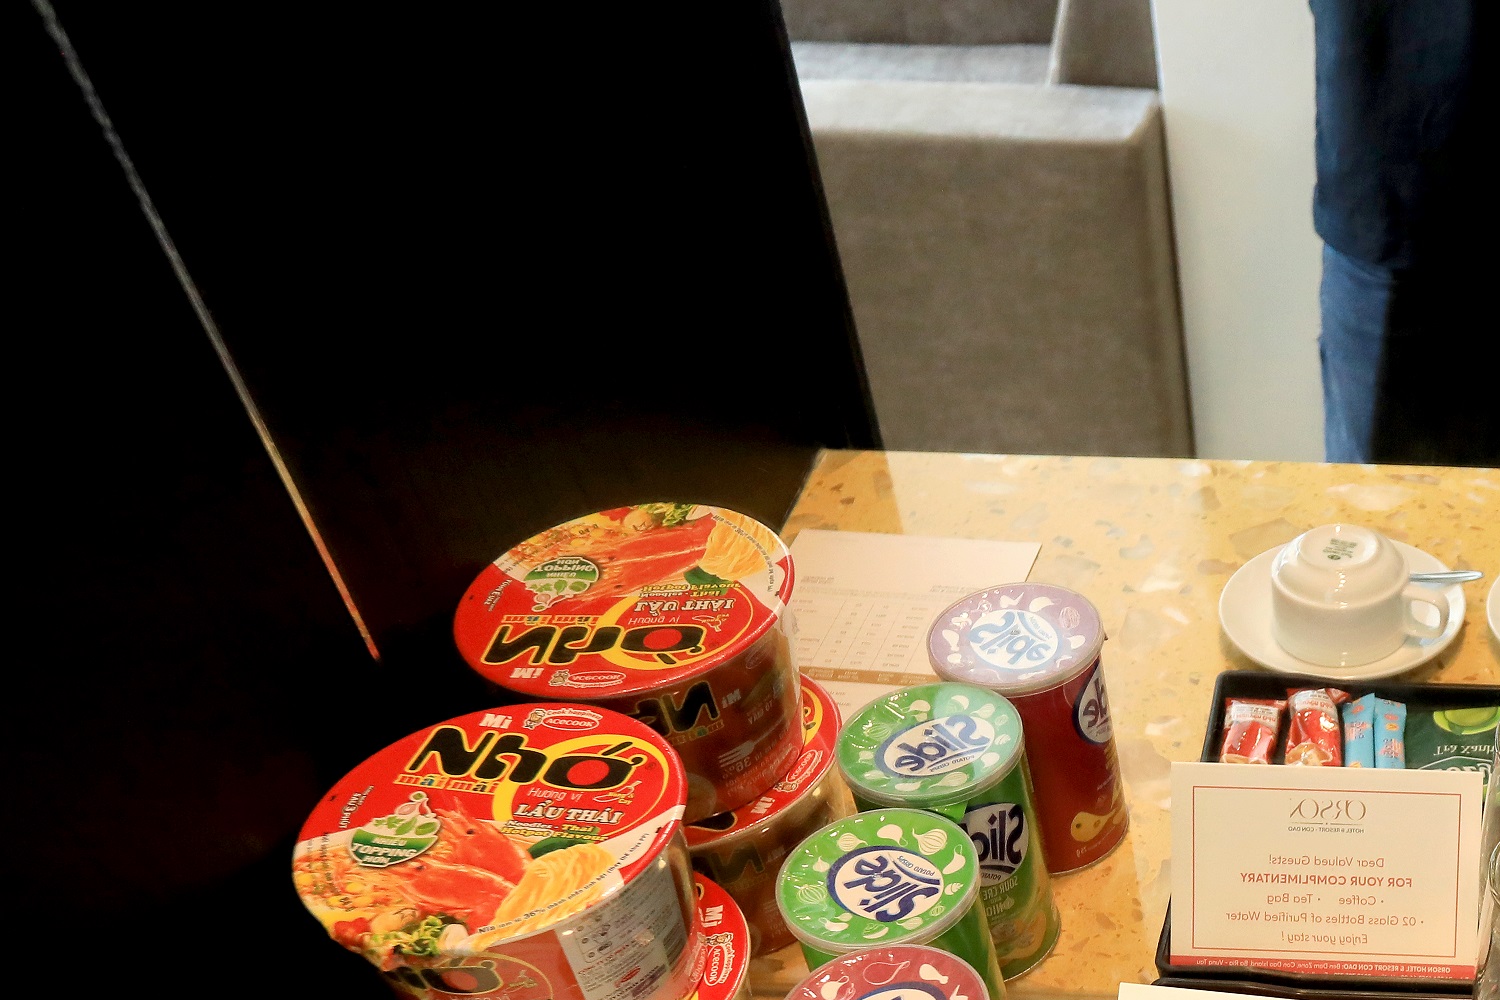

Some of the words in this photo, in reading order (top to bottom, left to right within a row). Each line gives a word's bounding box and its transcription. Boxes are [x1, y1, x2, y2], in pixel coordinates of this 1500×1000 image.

[479, 713, 513, 730] Mì
[406, 724, 645, 792] Nhớ
[570, 791, 583, 803] vị
[514, 800, 565, 819] LẨU
[565, 807, 624, 824] THÁI
[351, 843, 417, 858] TOPPING
